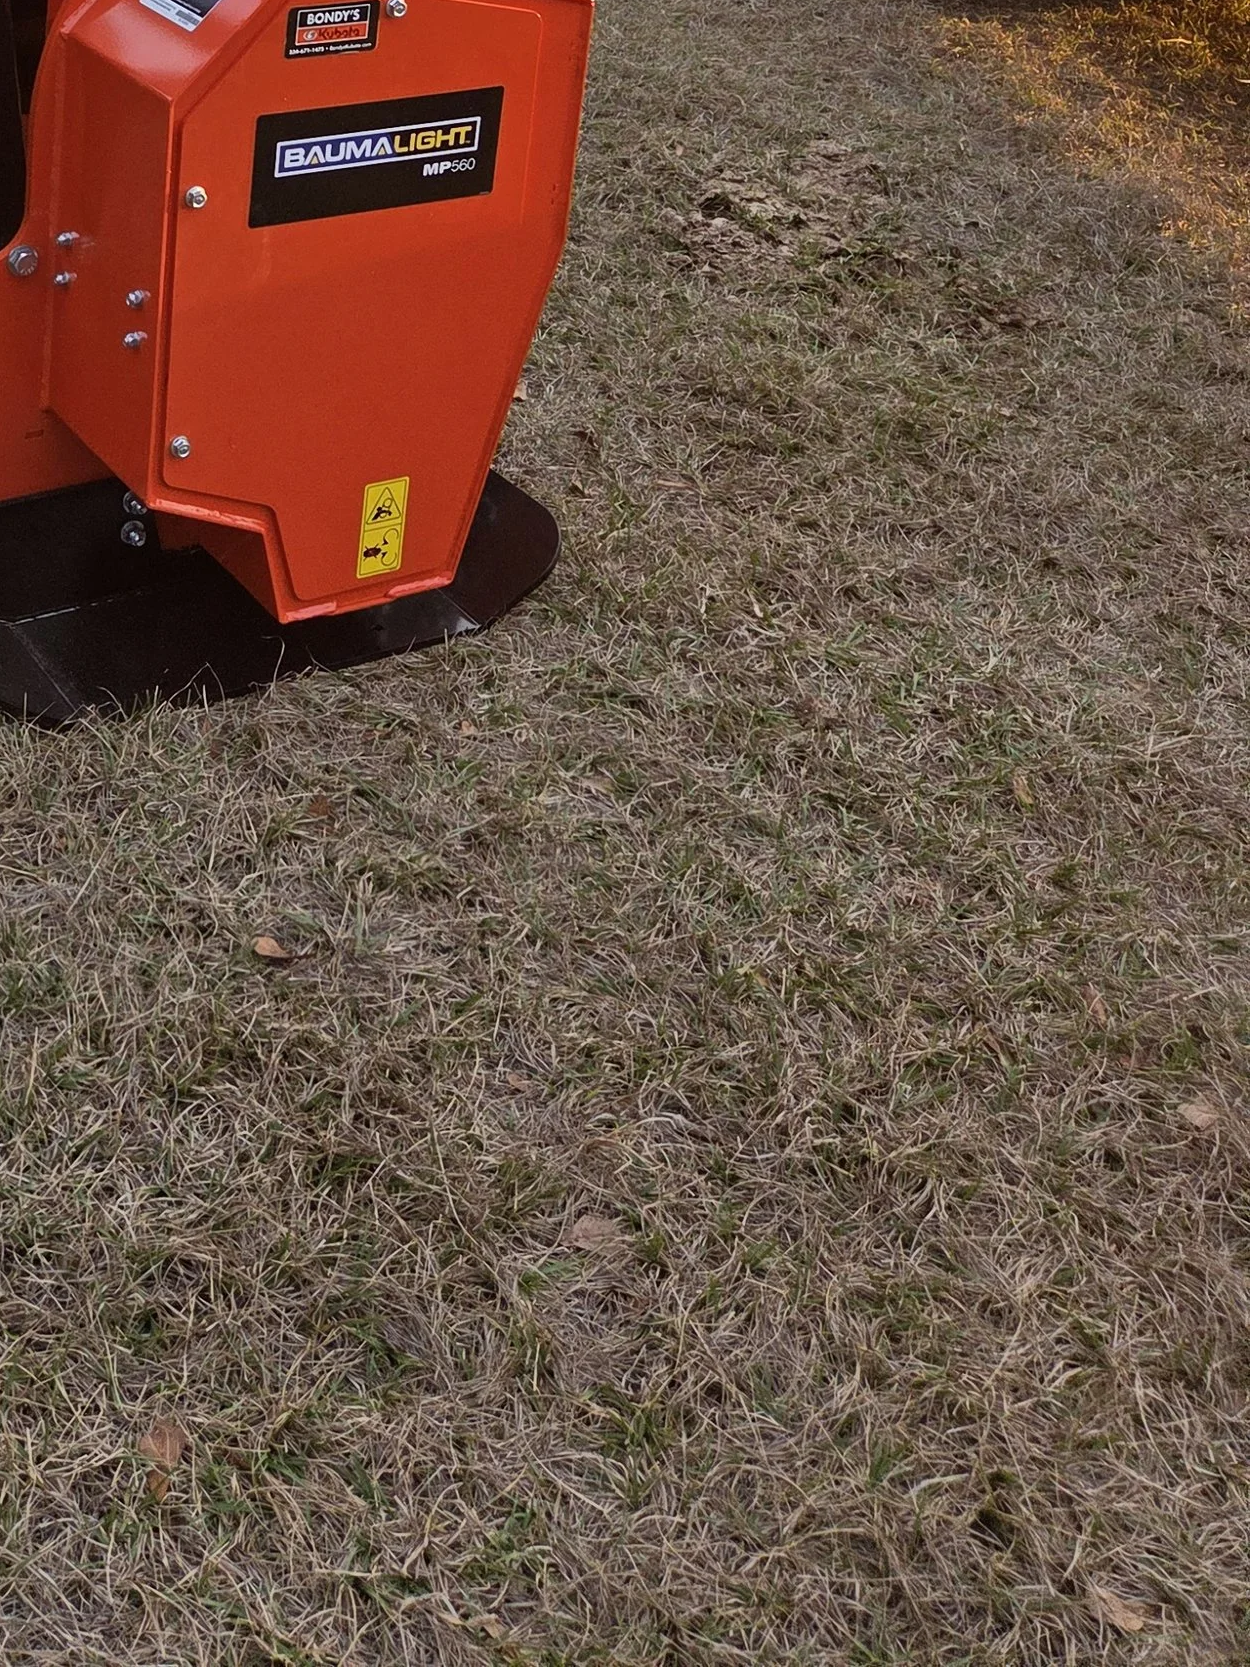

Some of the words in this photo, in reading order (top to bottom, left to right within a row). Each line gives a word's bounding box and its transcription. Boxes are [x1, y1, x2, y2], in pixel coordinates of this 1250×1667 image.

[306, 8, 361, 25] BONDY'S
[318, 26, 360, 40] Kubota
[283, 125, 472, 168] BAUMALIGHT
[422, 157, 476, 177] MP560
